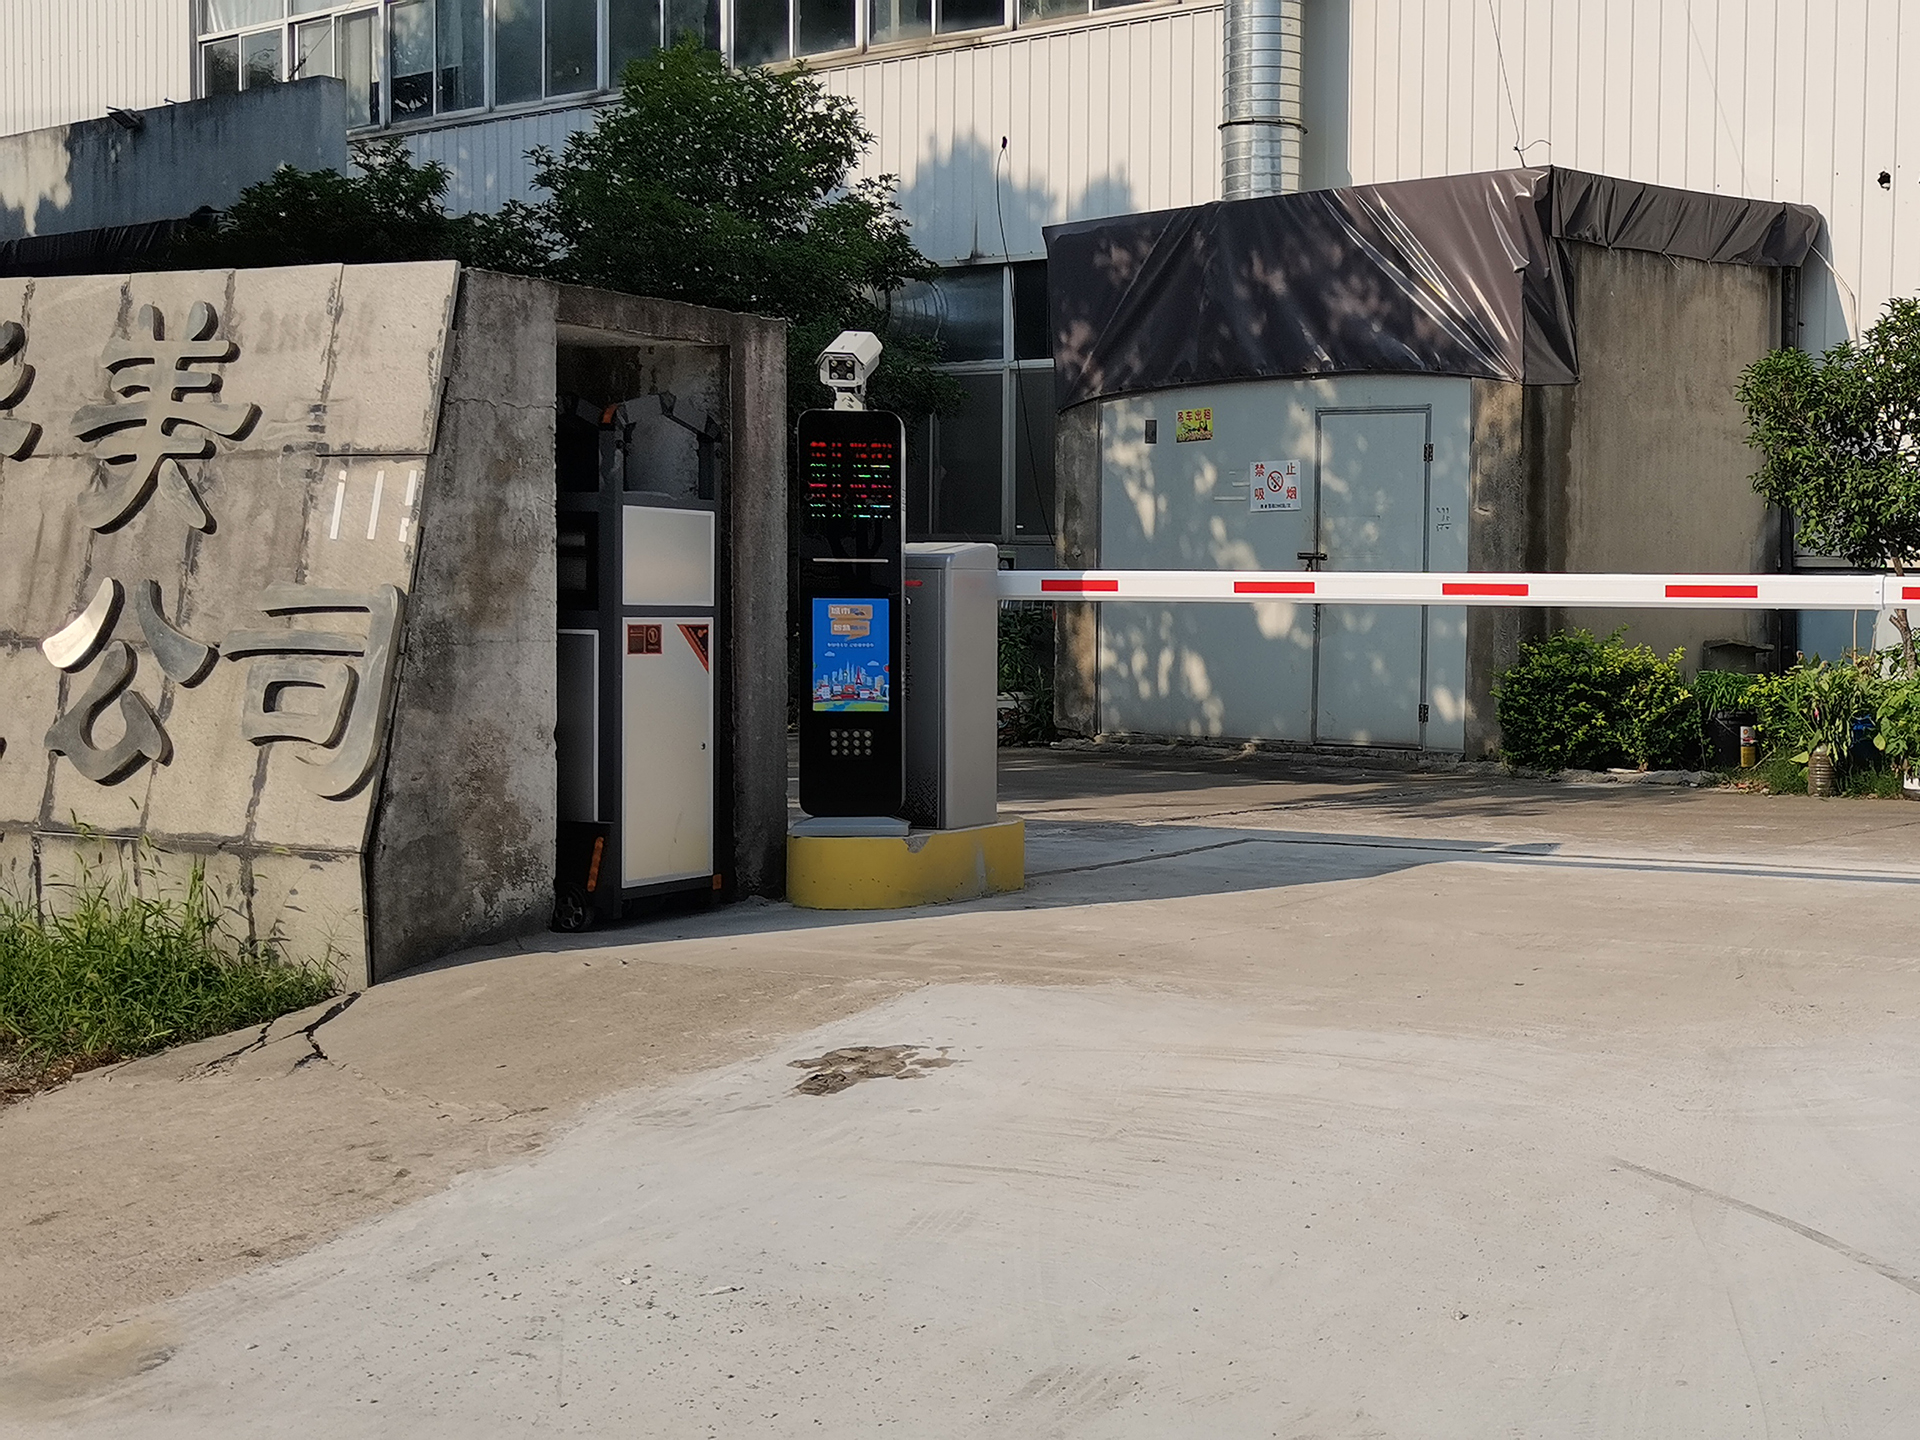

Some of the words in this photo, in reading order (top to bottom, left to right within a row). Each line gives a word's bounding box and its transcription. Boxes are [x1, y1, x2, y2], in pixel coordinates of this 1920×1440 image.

[0, 301, 262, 534] 美
[1177, 408, 1211, 422] 吊车出租
[1254, 462, 1297, 477] 禁止
[1254, 486, 1297, 501] 吸烟
[42, 576, 406, 801] 公司
